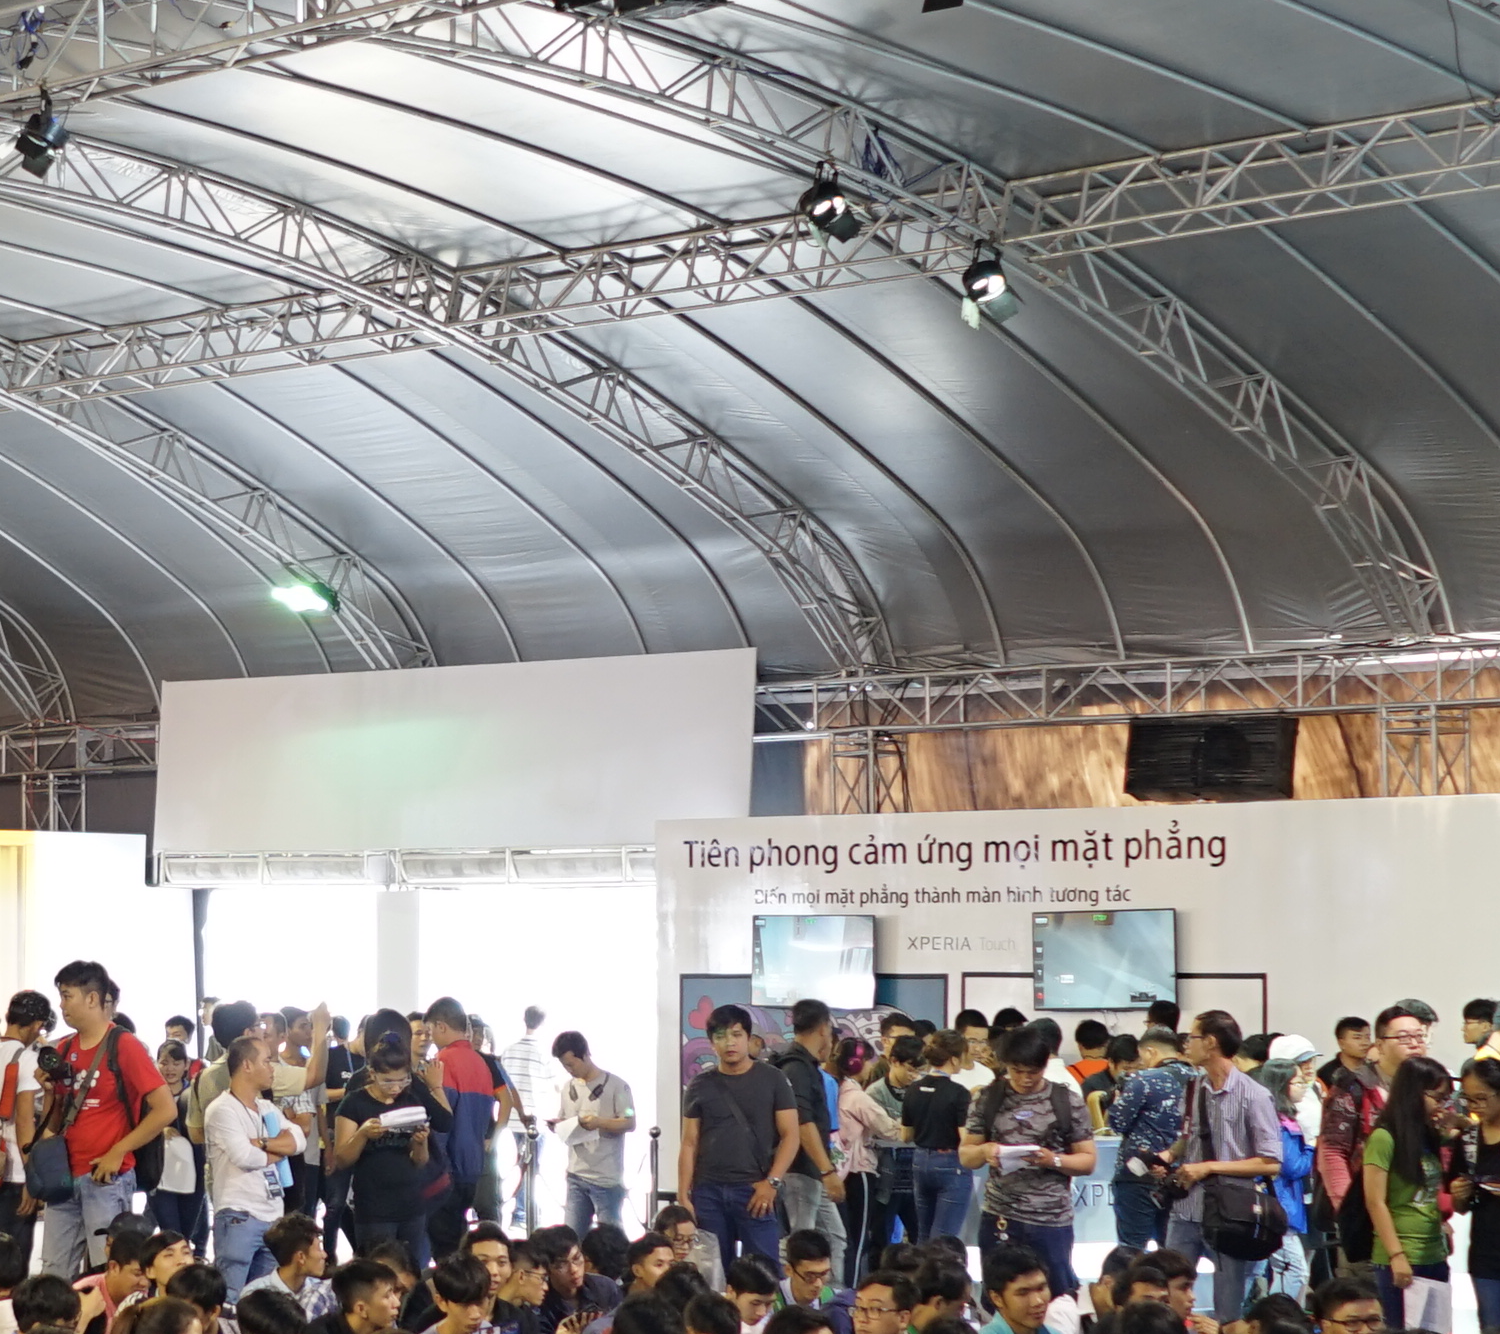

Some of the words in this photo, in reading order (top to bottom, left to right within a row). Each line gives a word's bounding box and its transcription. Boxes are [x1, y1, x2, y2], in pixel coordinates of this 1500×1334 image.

[683, 838, 740, 868] Tiên
[749, 837, 839, 874] phong
[848, 833, 908, 866] cảm
[917, 833, 973, 872] ứng
[983, 833, 1040, 870] mọi
[1050, 829, 1114, 869] mặt
[1124, 819, 1227, 868] phẳng
[791, 887, 821, 909] mọi
[824, 887, 856, 909] mặt
[859, 882, 909, 909] phẳng
[915, 884, 961, 904] thành
[966, 886, 1002, 904] màn
[1007, 885, 1043, 904] hình
[1049, 886, 1099, 908] tương
[1106, 883, 1132, 903] tác
[907, 936, 972, 951] XPERIA
